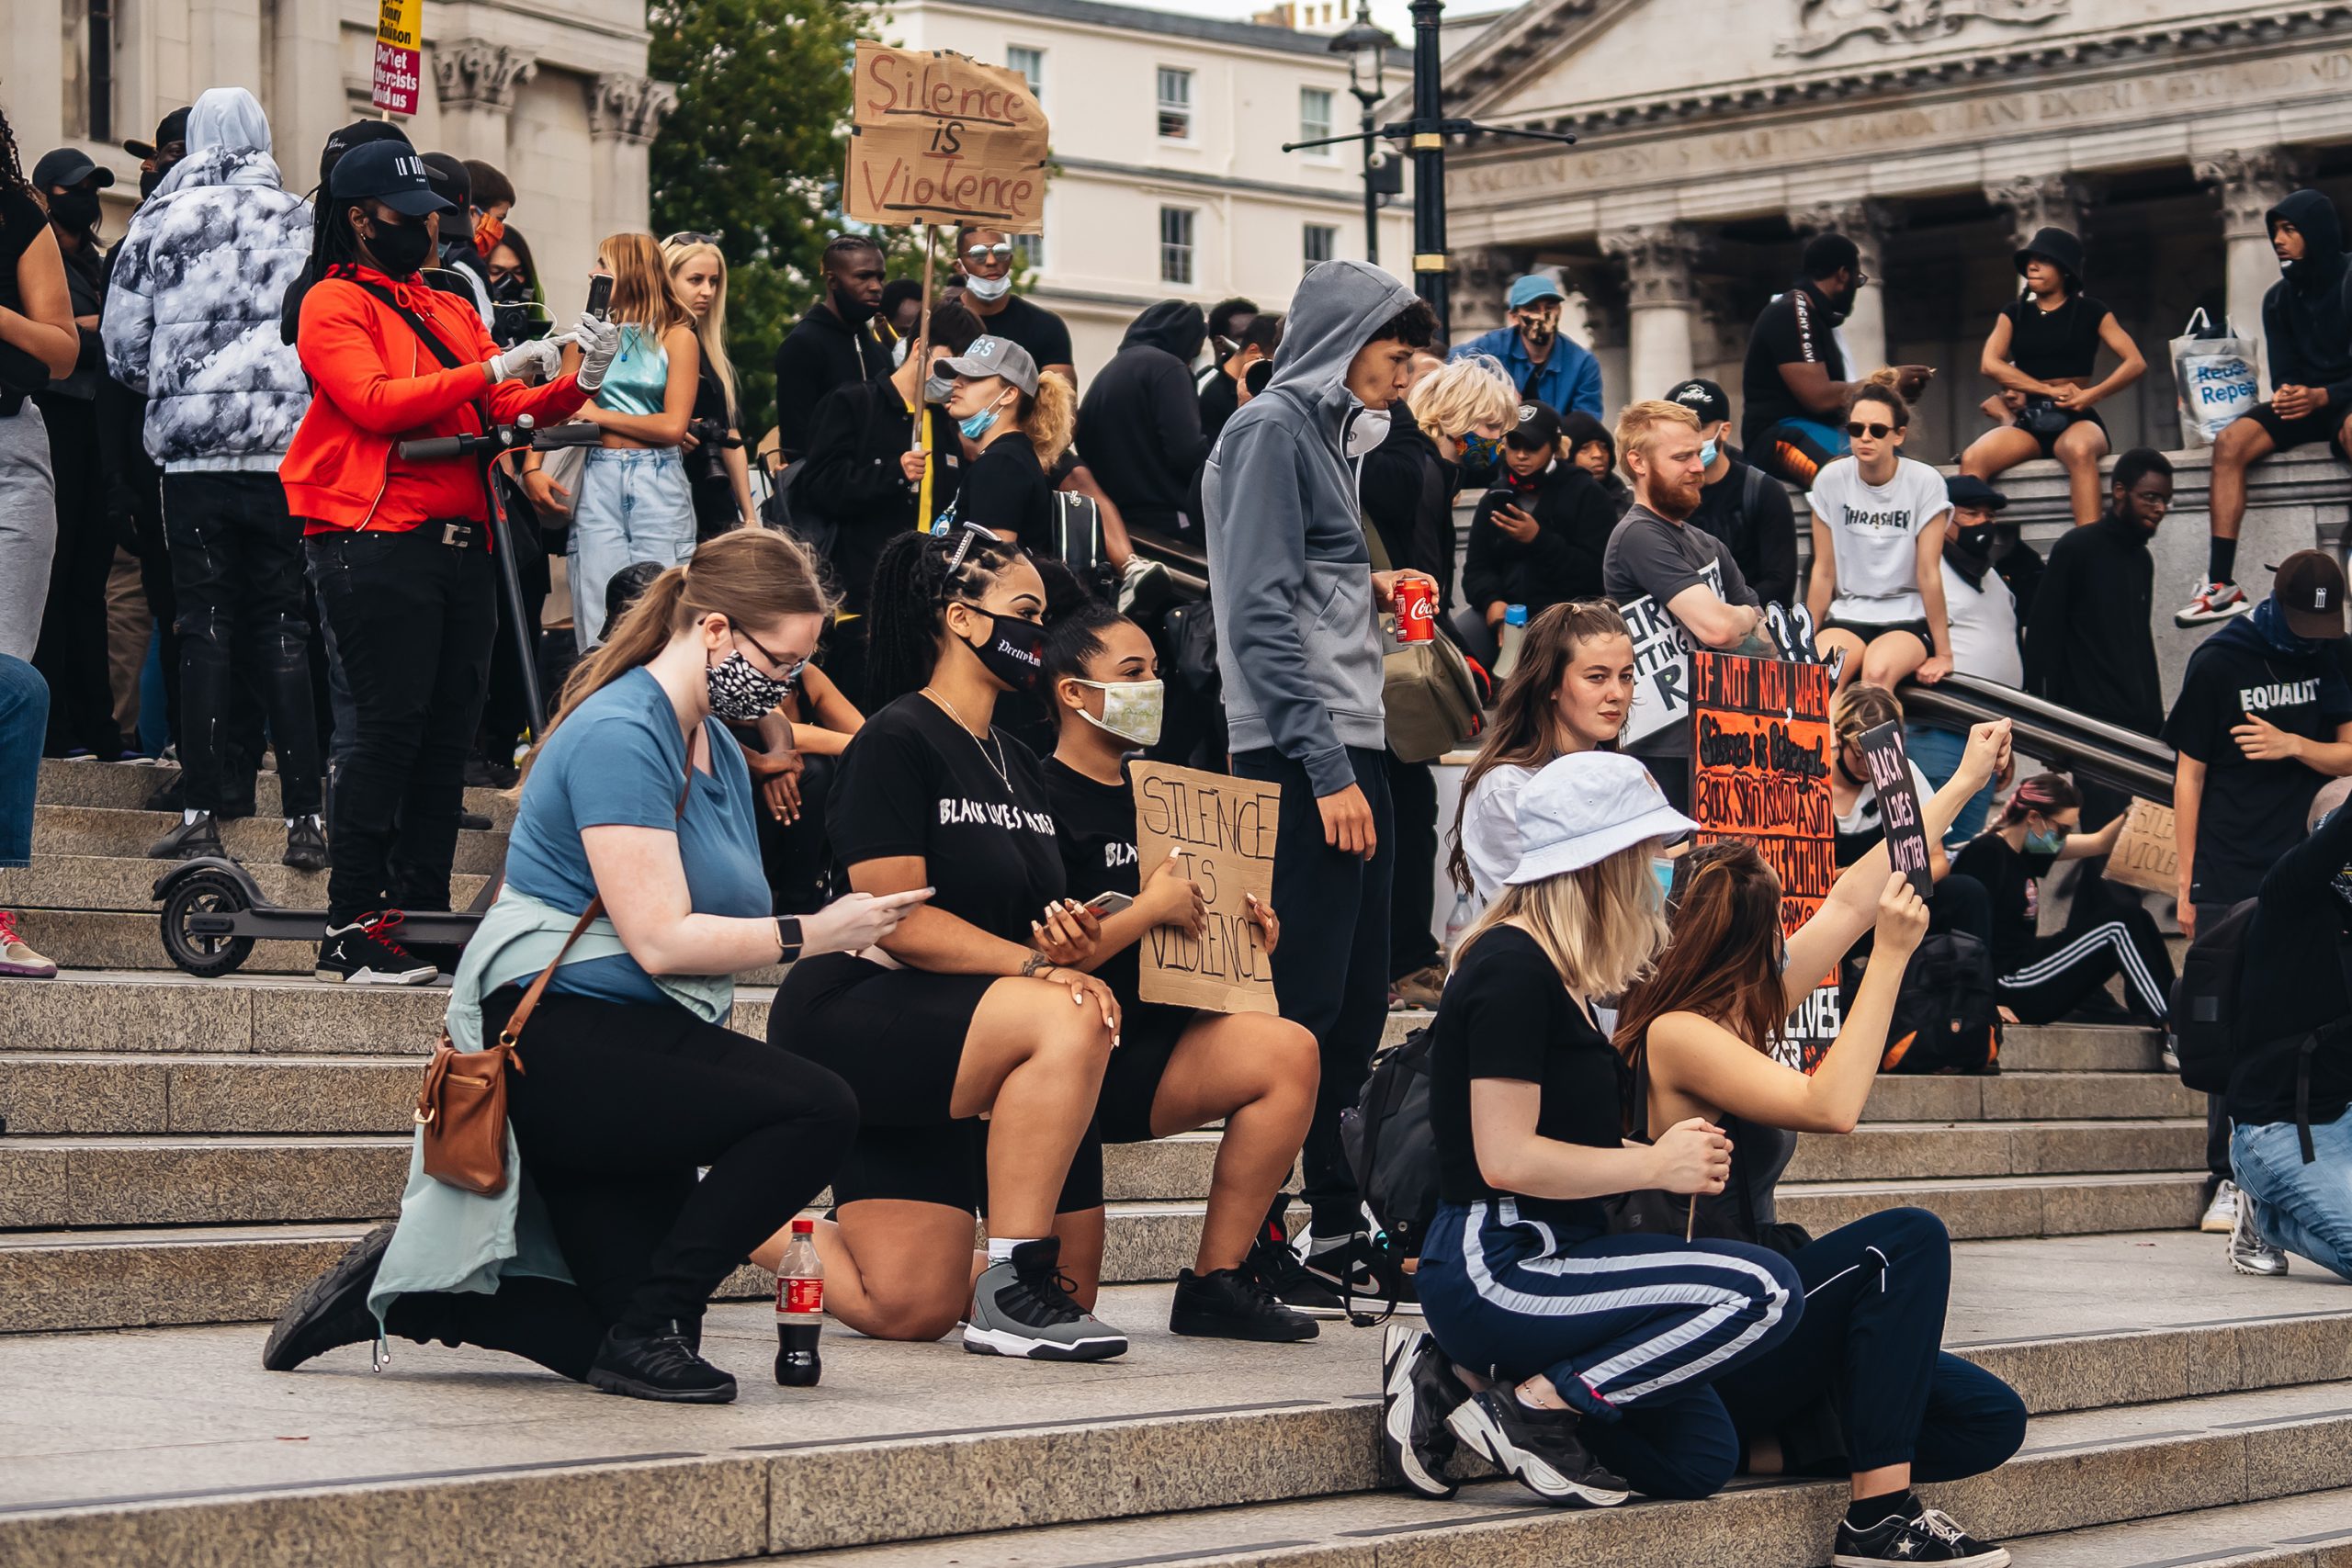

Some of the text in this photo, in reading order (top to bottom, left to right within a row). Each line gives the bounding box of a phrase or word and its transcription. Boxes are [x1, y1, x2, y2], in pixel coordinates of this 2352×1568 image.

[386, 70, 417, 91] rcists
[392, 94, 407, 107] us
[867, 54, 1028, 123] Silence
[862, 156, 1033, 217] Violence
[1843, 503, 1911, 530] THRASHER
[1695, 650, 1714, 701] IF
[1721, 654, 1750, 706] NOT
[1794, 663, 1830, 719] WHEN
[1868, 746, 1904, 792] BLACK
[1143, 776, 1281, 861] SILENCE
[1885, 790, 1915, 829] LIVES
[1894, 834, 1927, 874] MATTER
[1150, 911, 1273, 983] VIOLENCE
